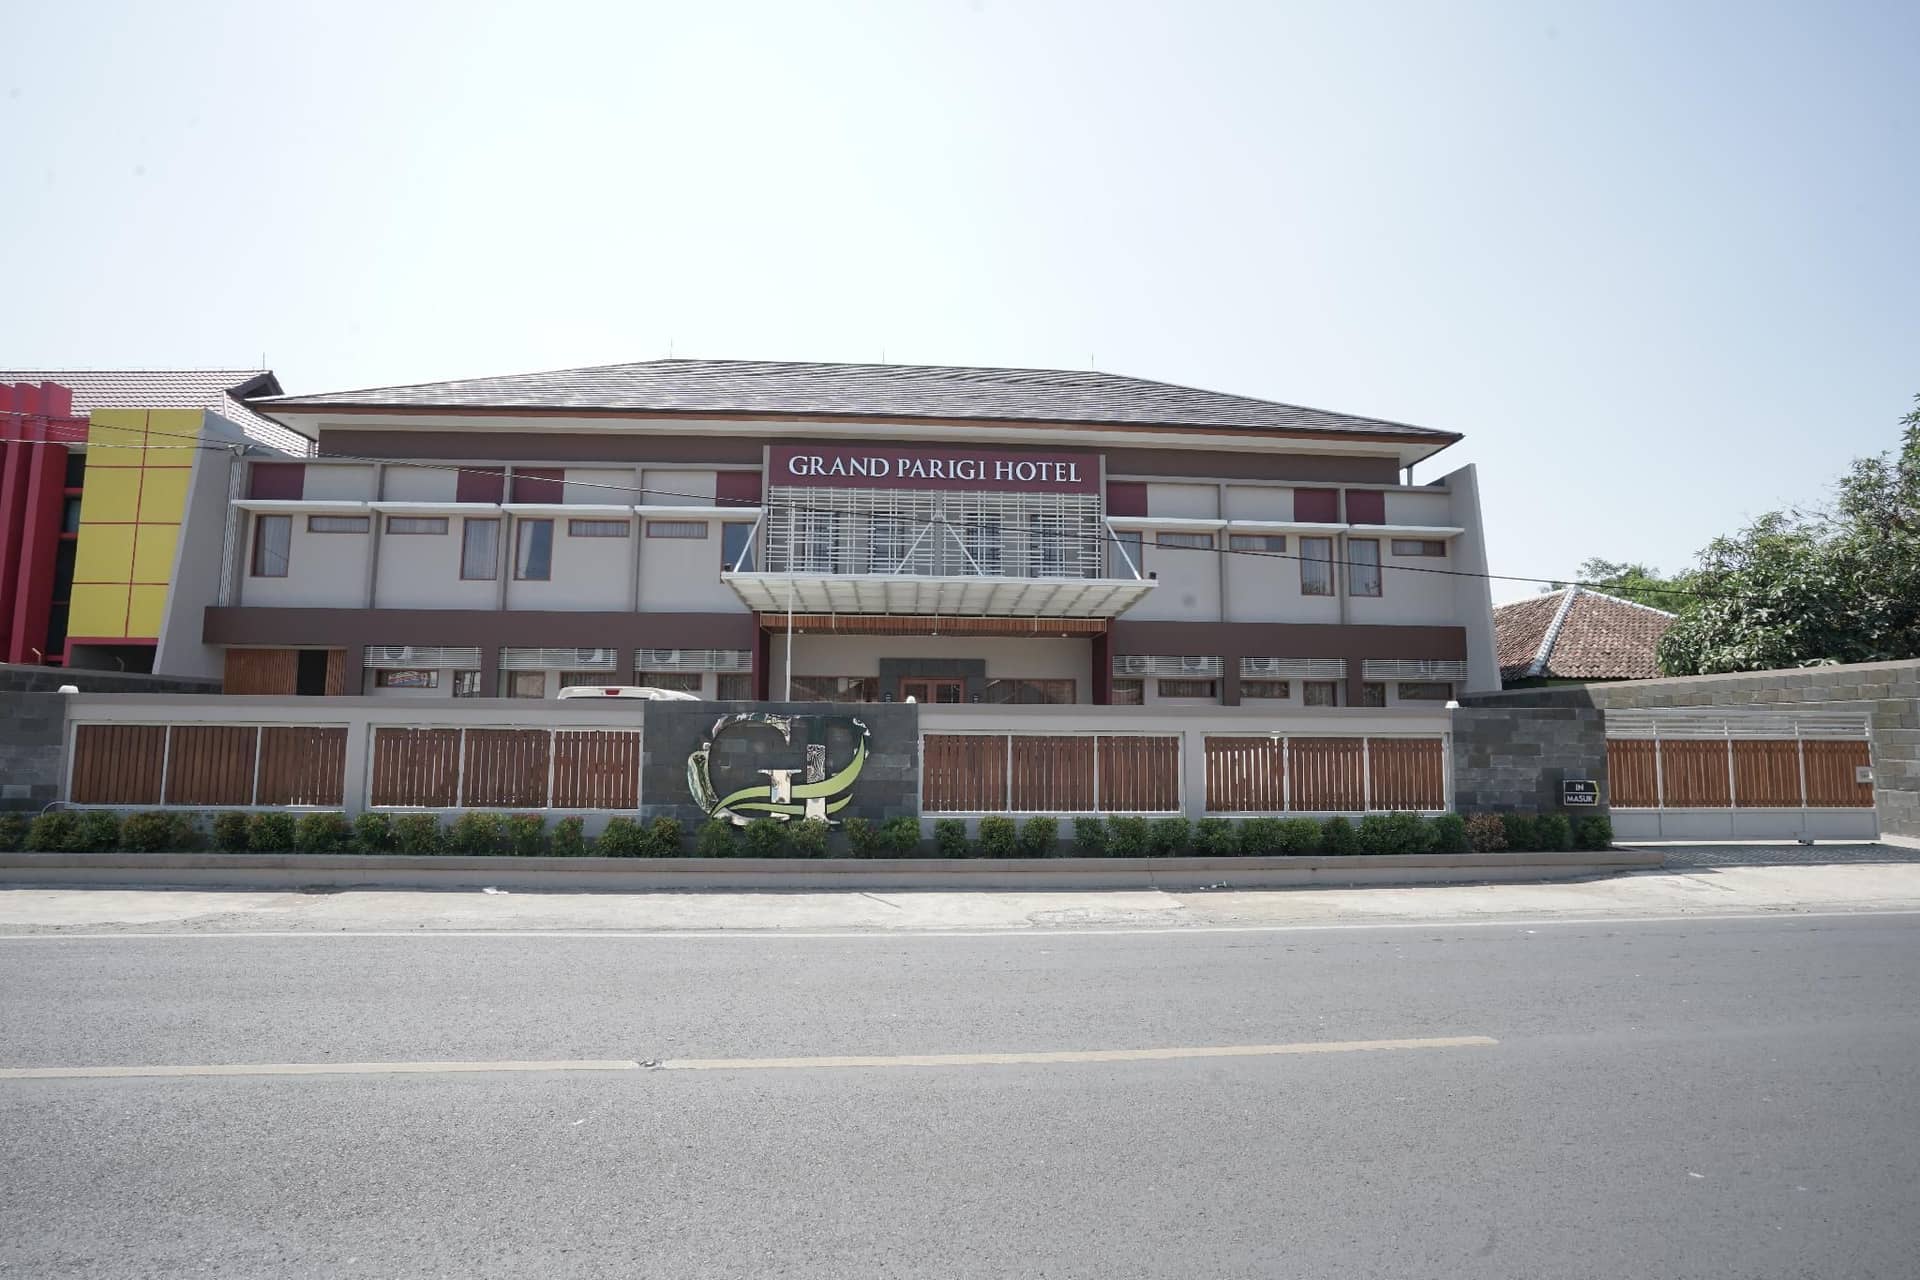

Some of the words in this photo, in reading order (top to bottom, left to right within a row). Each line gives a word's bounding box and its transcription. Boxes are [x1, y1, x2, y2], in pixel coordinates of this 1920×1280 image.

[788, 455, 890, 477] GRAND
[897, 459, 986, 480] PARIGI
[995, 461, 1081, 482] HOTEL
[1575, 783, 1584, 791] IN
[1567, 795, 1593, 803] MASUK
